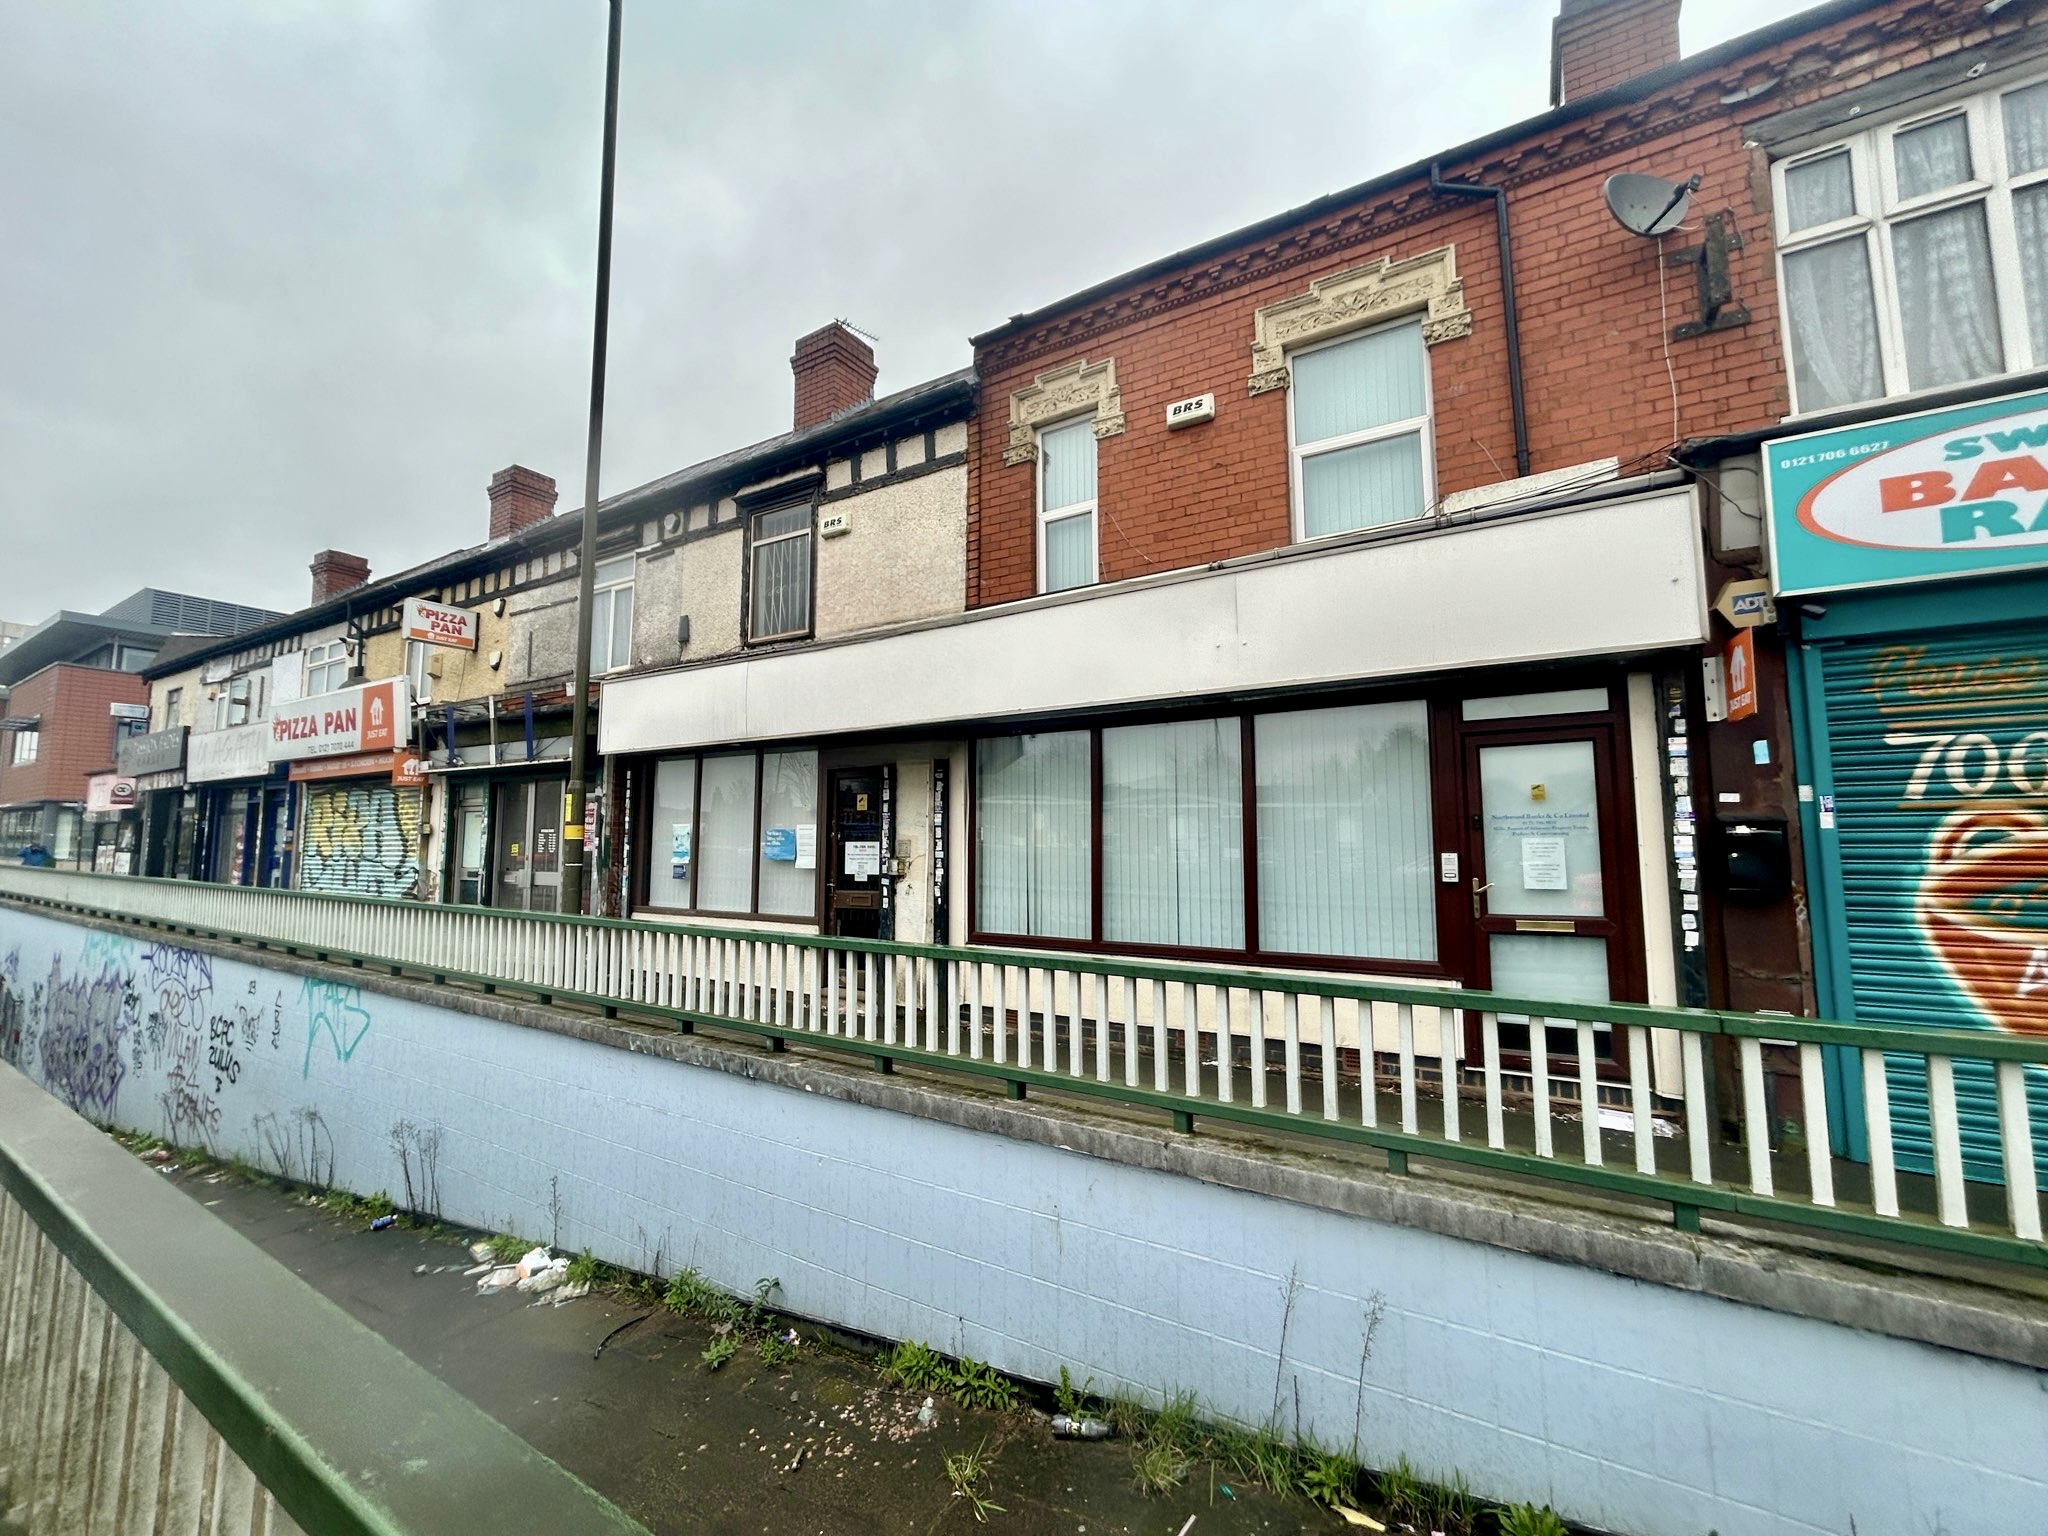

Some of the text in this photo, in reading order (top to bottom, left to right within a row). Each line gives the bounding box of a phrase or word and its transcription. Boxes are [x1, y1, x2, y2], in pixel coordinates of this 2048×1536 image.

[1172, 398, 1204, 416] BRS
[1780, 440, 1890, 469] 0121 706 6627
[823, 516, 843, 529] BRS
[1939, 496, 2048, 544] R
[1733, 594, 1767, 613] ADT
[424, 608, 468, 627] PIZZA
[430, 620, 463, 636] PAN
[278, 707, 357, 742] PIZZA PAN
[366, 727, 389, 740] JUST EAT
